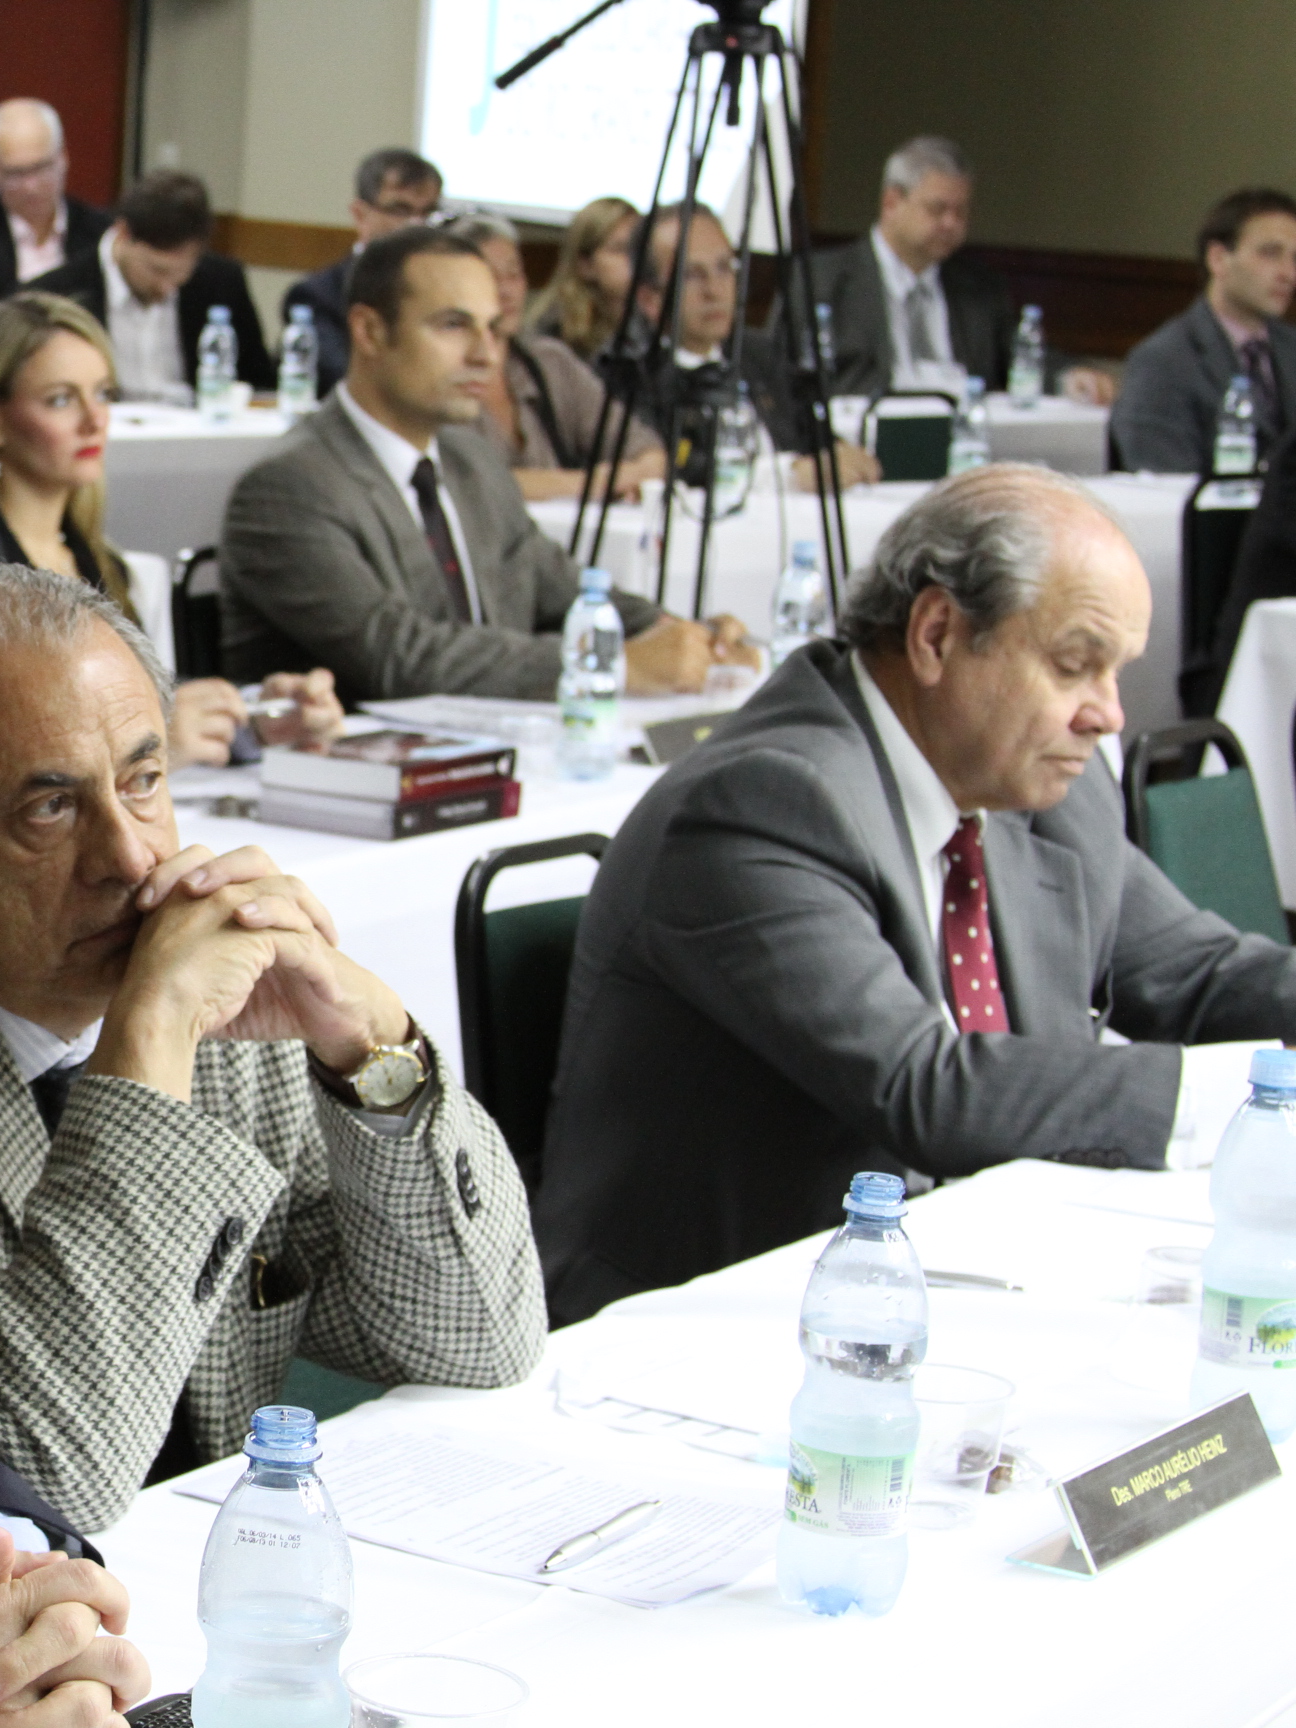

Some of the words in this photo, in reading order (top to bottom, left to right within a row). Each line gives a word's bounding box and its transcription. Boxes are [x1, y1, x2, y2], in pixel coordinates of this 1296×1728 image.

[1110, 1486, 1134, 1507] Des.
[1129, 1464, 1165, 1497] MARCO
[1162, 1447, 1201, 1481] AURÉLIO
[1197, 1433, 1228, 1463] HEINZ
[268, 1539, 276, 1547] 01
